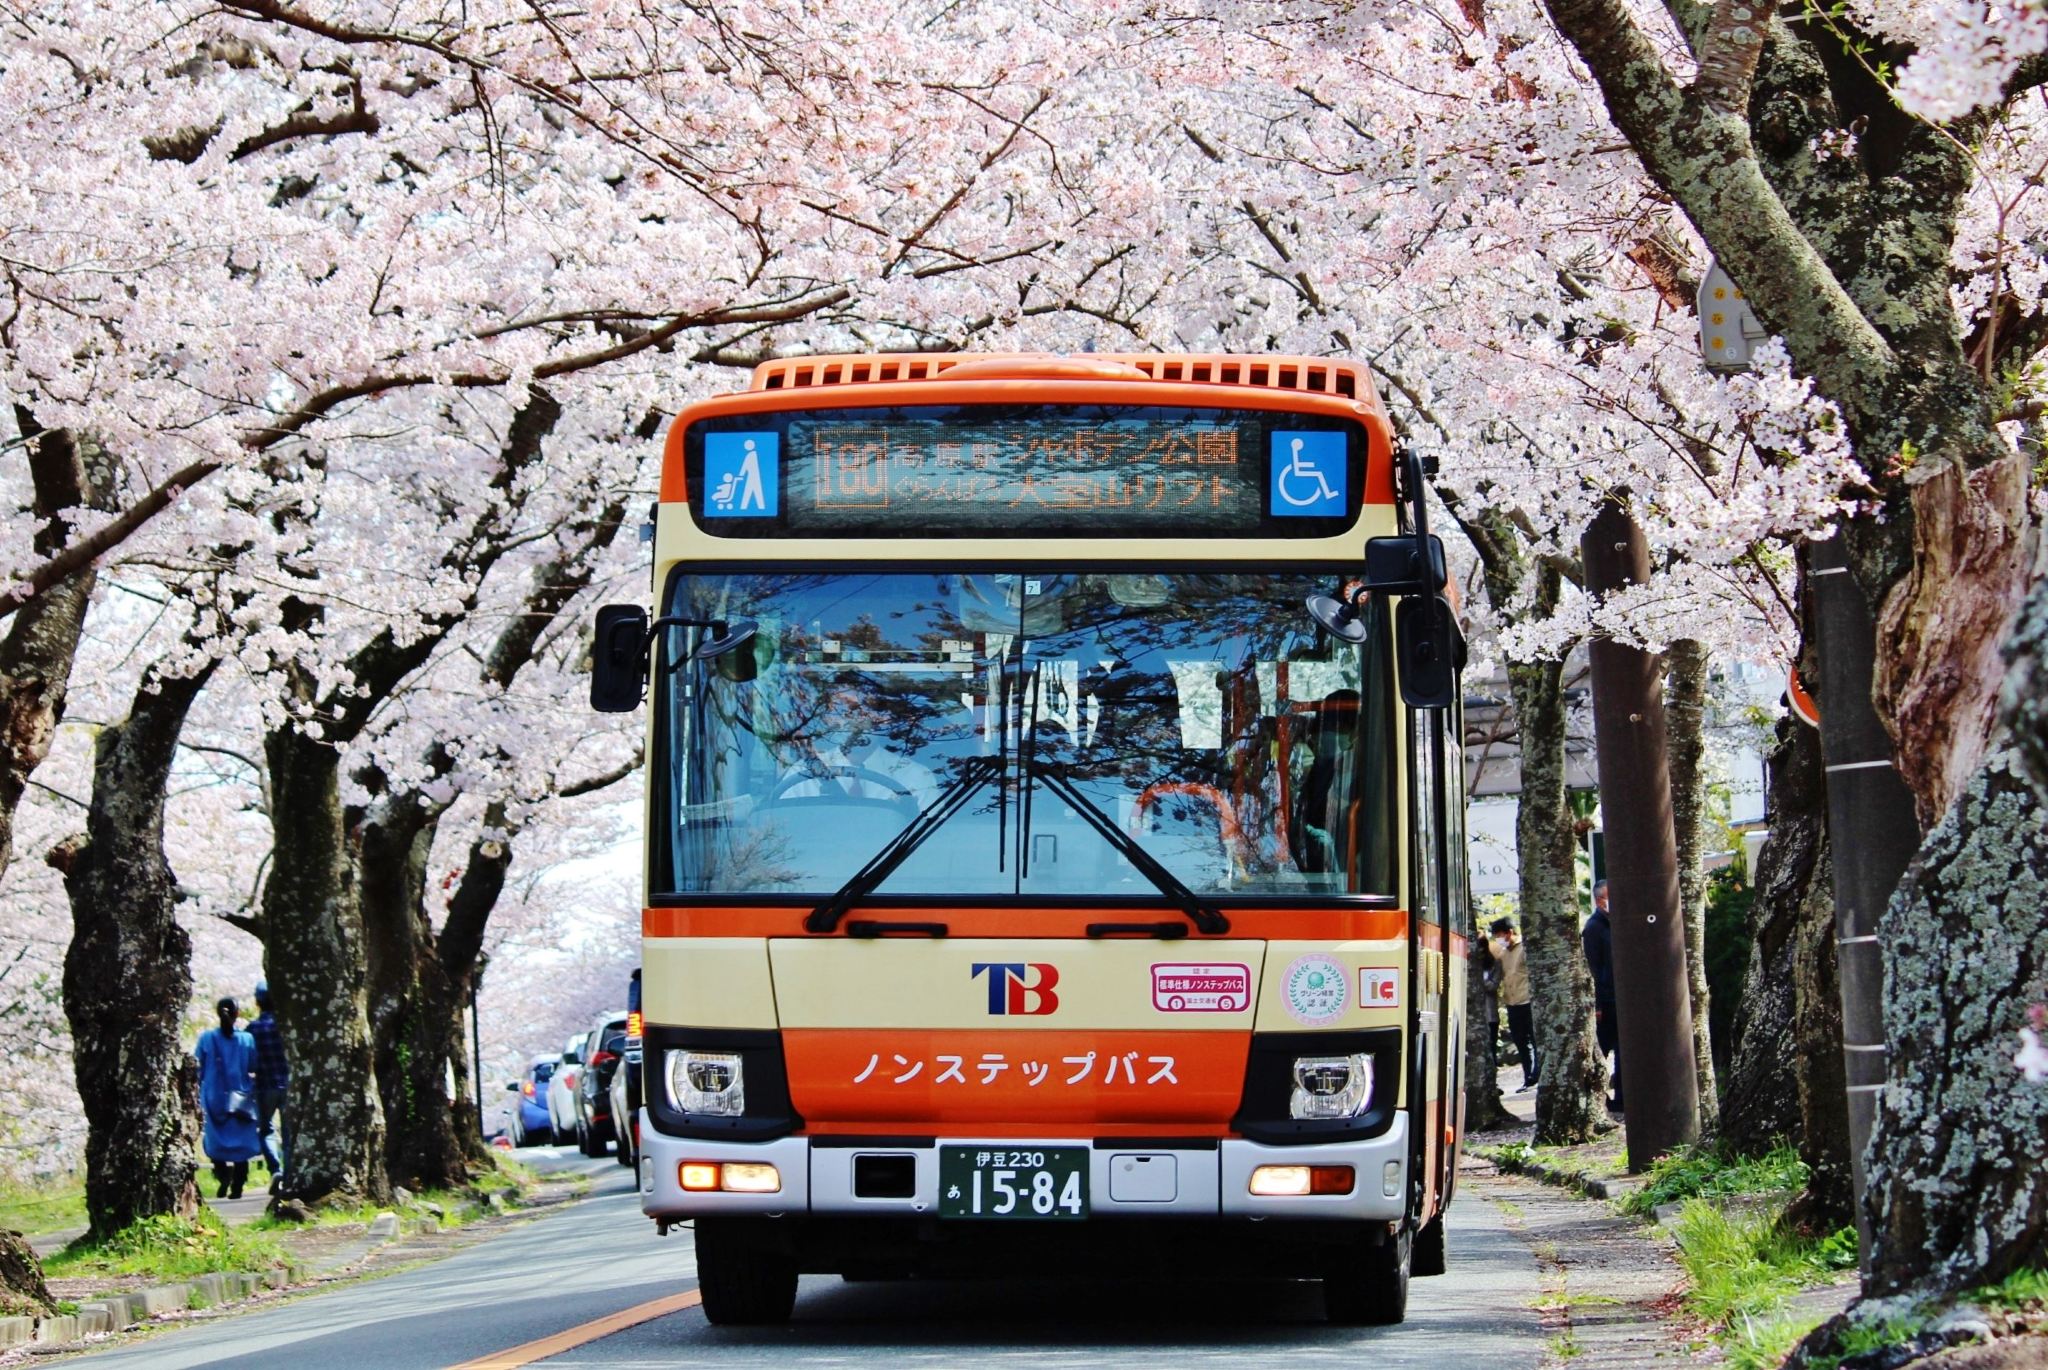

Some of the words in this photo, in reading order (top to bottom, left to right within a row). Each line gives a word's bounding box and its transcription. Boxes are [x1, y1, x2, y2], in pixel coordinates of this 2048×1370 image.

[817, 442, 882, 496] 180
[1159, 979, 1244, 990] 標準仕様ノンステップバス
[853, 1050, 1178, 1087] ノンステップバス
[947, 1184, 961, 1199] あ
[972, 1170, 1082, 1214] 15-84
